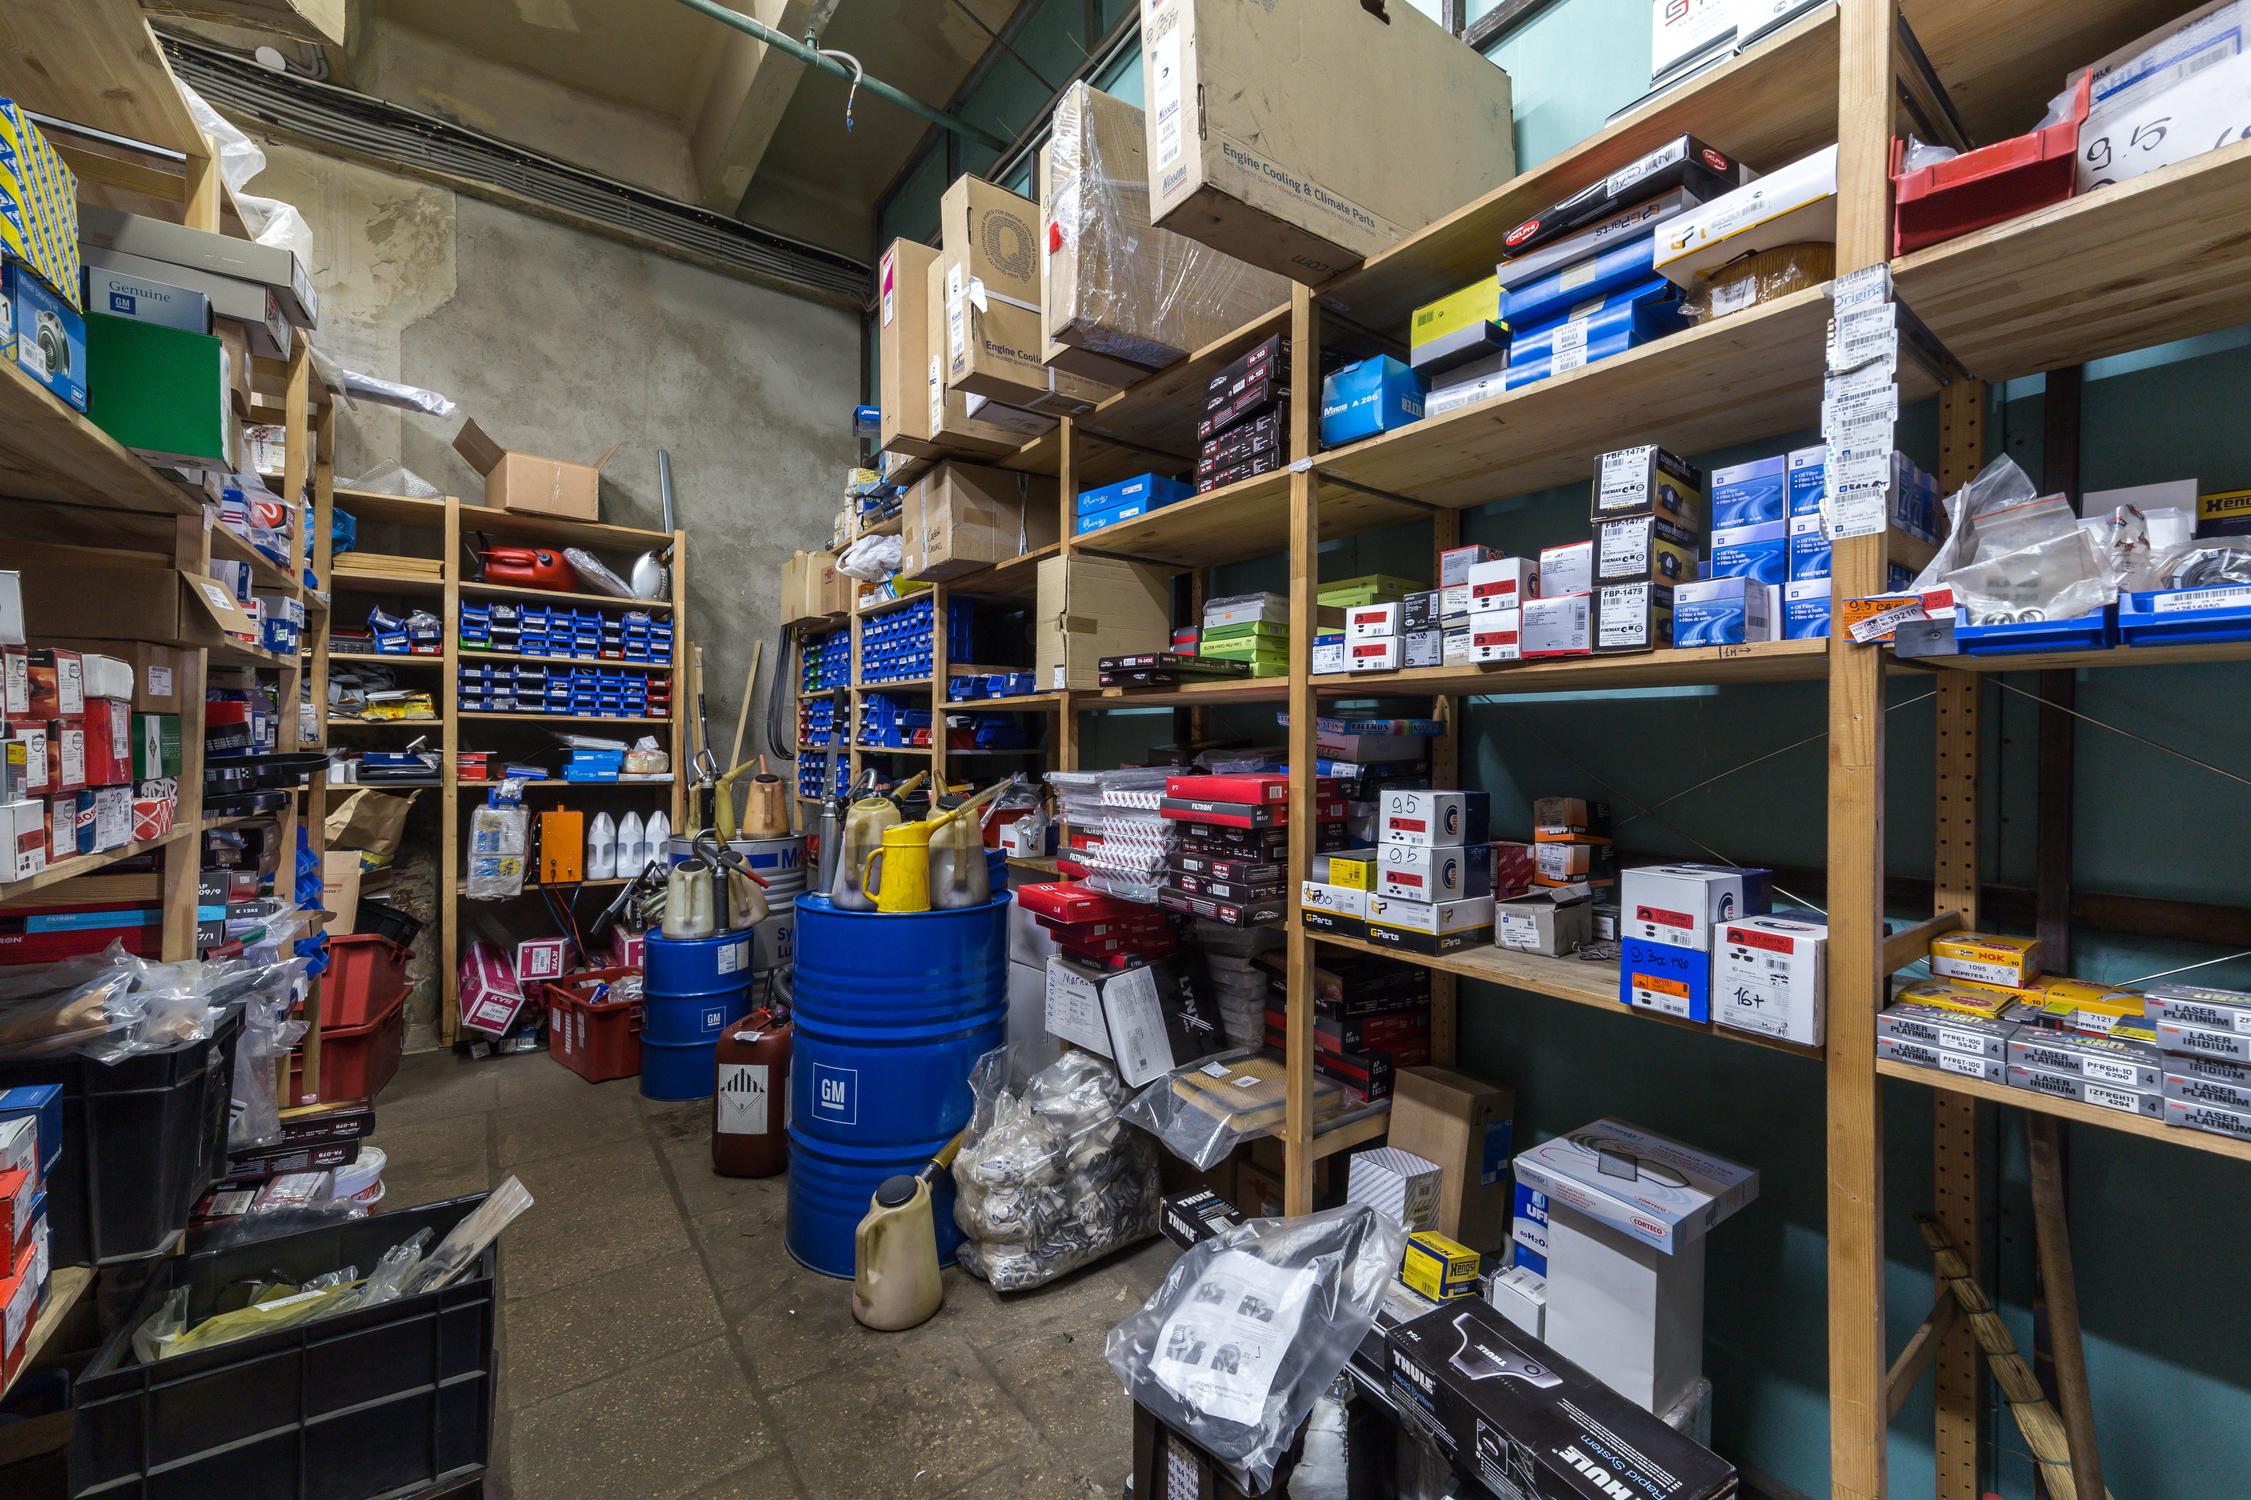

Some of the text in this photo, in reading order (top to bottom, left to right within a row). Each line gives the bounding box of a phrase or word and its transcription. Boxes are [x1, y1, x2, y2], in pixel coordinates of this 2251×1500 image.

[2087, 116, 2172, 172] 9.5
[1223, 142, 1376, 229] Engine Cooling & Climate Parts
[1508, 223, 1538, 244] DELPHI
[109, 280, 171, 303] Genuine
[115, 297, 130, 308] GM
[986, 340, 1016, 359] Engine
[1249, 349, 1266, 365] FA-103
[1248, 368, 1264, 383] FA-103
[1605, 447, 1646, 460] FBP-1479
[1603, 587, 1643, 598] FBP-1479
[1191, 802, 1214, 811] FILTRON
[1305, 912, 1333, 926] GParts
[1370, 926, 1400, 942] GParts
[1440, 936, 1461, 950] GParts
[1978, 951, 2006, 964] NGK
[1950, 969, 1994, 981] BCPR7ES-11
[1968, 963, 1987, 972] 1095
[1733, 986, 1766, 1009] 16+
[707, 1012, 721, 1024] GM
[2091, 1013, 2111, 1023] 7121
[2175, 1004, 2217, 1017] LASER
[1898, 1020, 1928, 1032] LASER
[2163, 1010, 2230, 1027] PLATINUM
[1890, 1026, 1937, 1041] PLATINUM
[1942, 1033, 1981, 1046] PFR6T-100
[2190, 1031, 2232, 1045] LASER
[1898, 1043, 1928, 1055] LASER
[1958, 1041, 1978, 1050] 5542
[2183, 1037, 2239, 1054] IRIDIUM
[1890, 1047, 1937, 1063] PLATINUM
[2024, 1053, 2080, 1070] PLATINUM
[2033, 1048, 2069, 1061] LASER
[1943, 1056, 1981, 1069] PFR6T-100
[1958, 1065, 1978, 1074] 5542
[2087, 1062, 2133, 1076] PFR6H-10
[2105, 1071, 2129, 1081] 6290
[2189, 1063, 2246, 1080] IRIDIUM
[2030, 1079, 2076, 1096] IRIDIUM
[2035, 1074, 2071, 1087] LASER
[820, 1078, 845, 1104] GM
[2089, 1088, 2134, 1103] IZFR6H11
[2194, 1082, 2237, 1096] LASER
[2107, 1099, 2130, 1108] 4294
[2182, 1087, 2249, 1107] PLATINUM
[2185, 1114, 2251, 1134] PLATINUM
[2197, 1109, 2240, 1124] LASER
[1684, 1154, 1734, 1176] AIR FILTER
[1176, 1189, 1215, 1208] THULE
[1168, 1210, 1196, 1243] THULE
[1633, 1218, 1663, 1235] CORTECO
[1478, 1343, 1508, 1367] THULE
[1392, 1349, 1434, 1395] THULE
[1392, 1370, 1436, 1412] Rapid System
[1558, 1444, 1643, 1500] HULE
[1579, 1433, 1667, 1500] System Rapid
